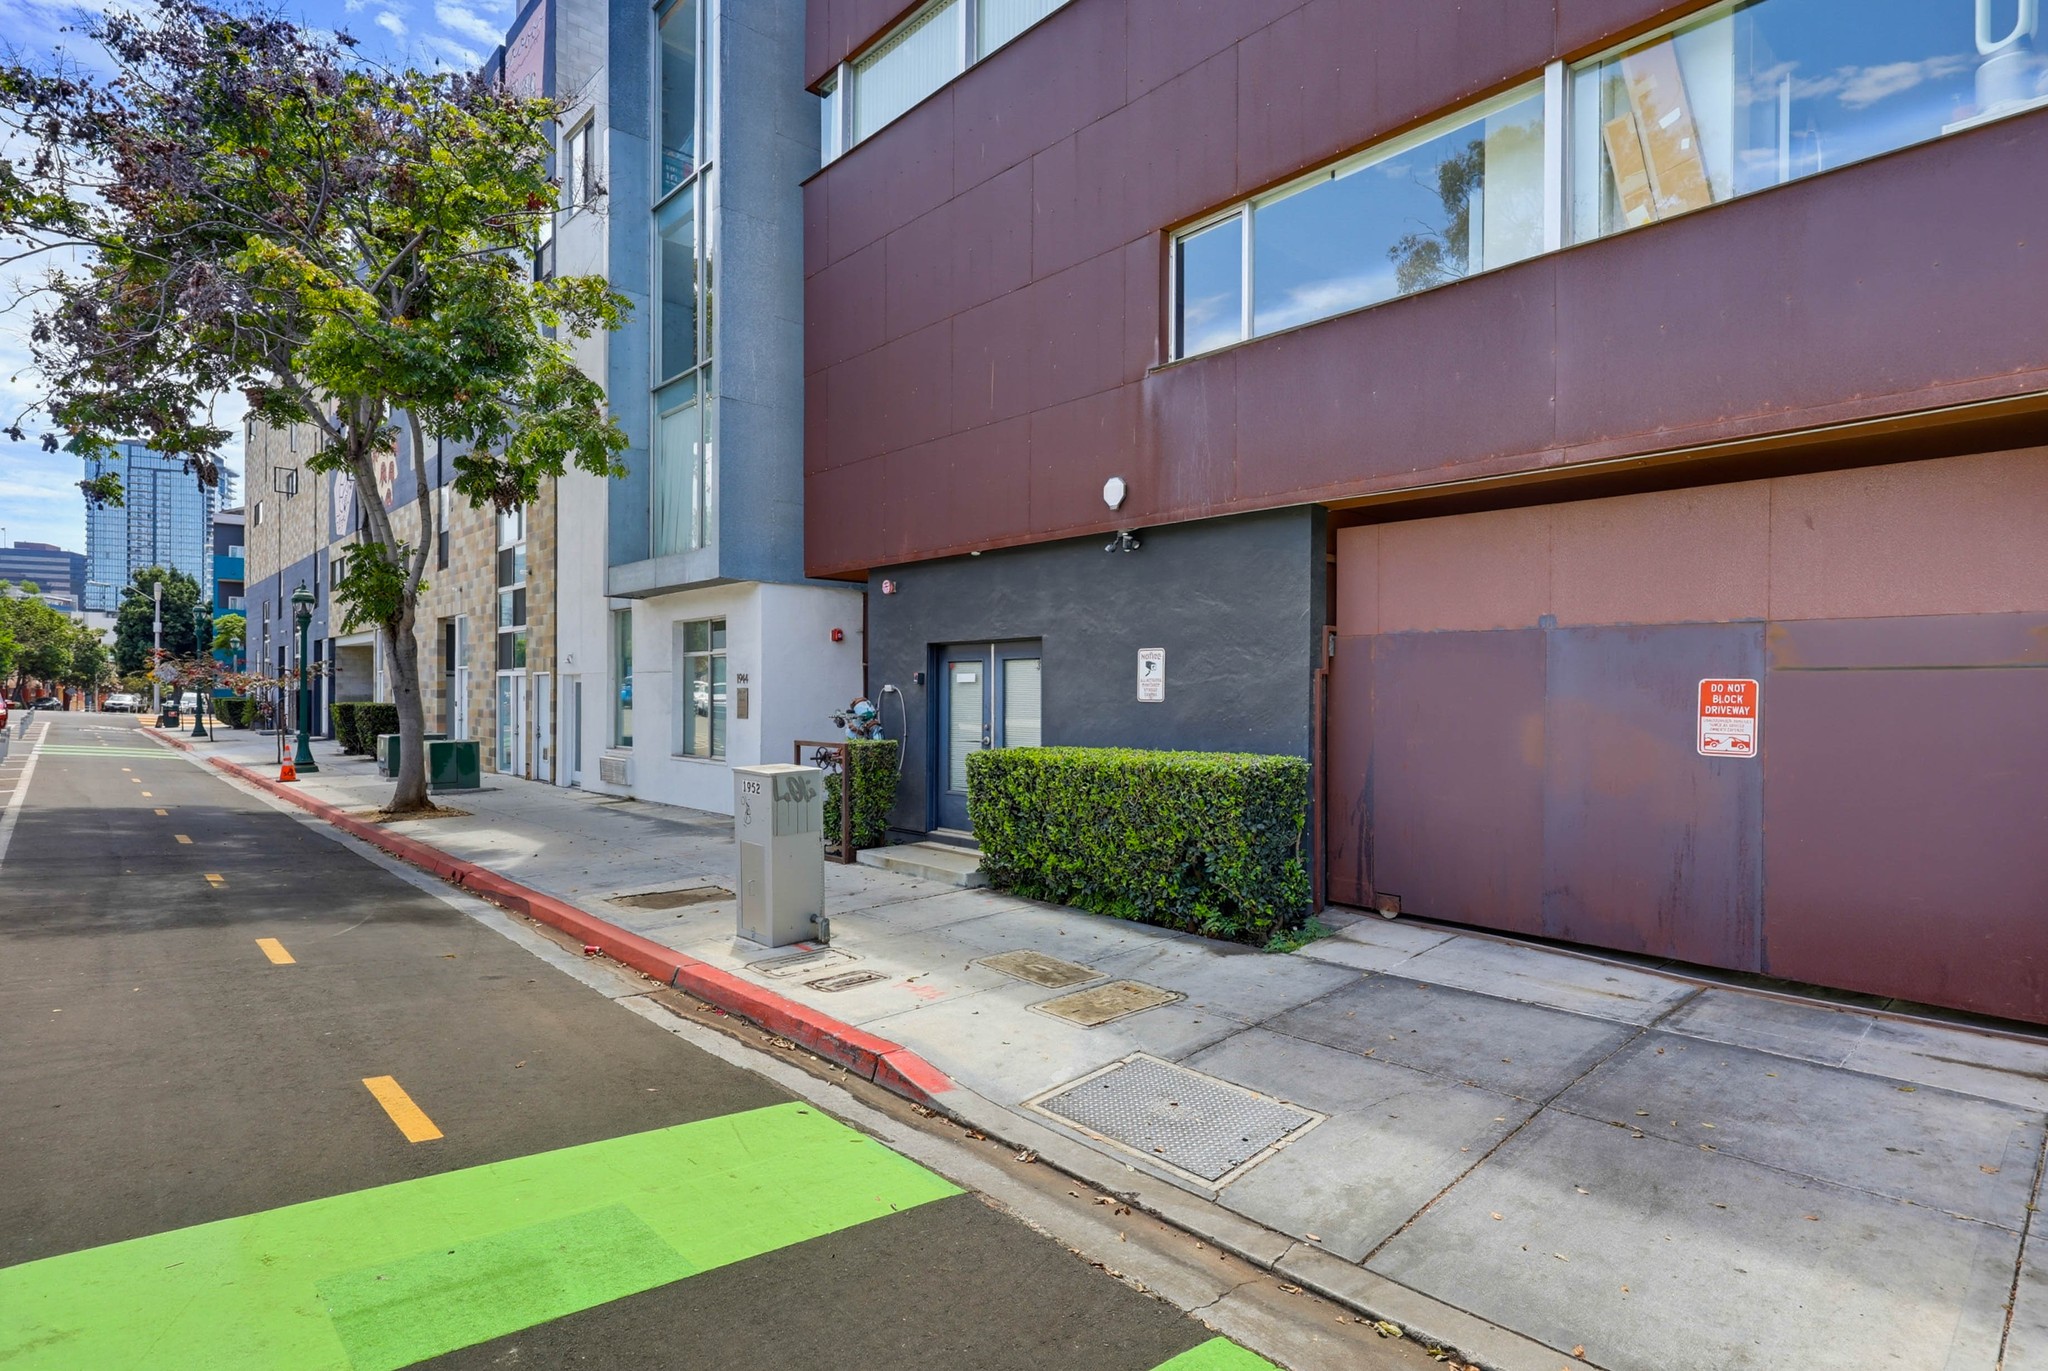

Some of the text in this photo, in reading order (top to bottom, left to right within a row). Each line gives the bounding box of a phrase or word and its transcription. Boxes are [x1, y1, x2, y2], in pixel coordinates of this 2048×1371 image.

[1711, 683, 1746, 693] DO NOT
[1712, 694, 1744, 704] BLOCK
[1705, 705, 1750, 715] DRIVEWAY
[743, 780, 761, 794] 1952
